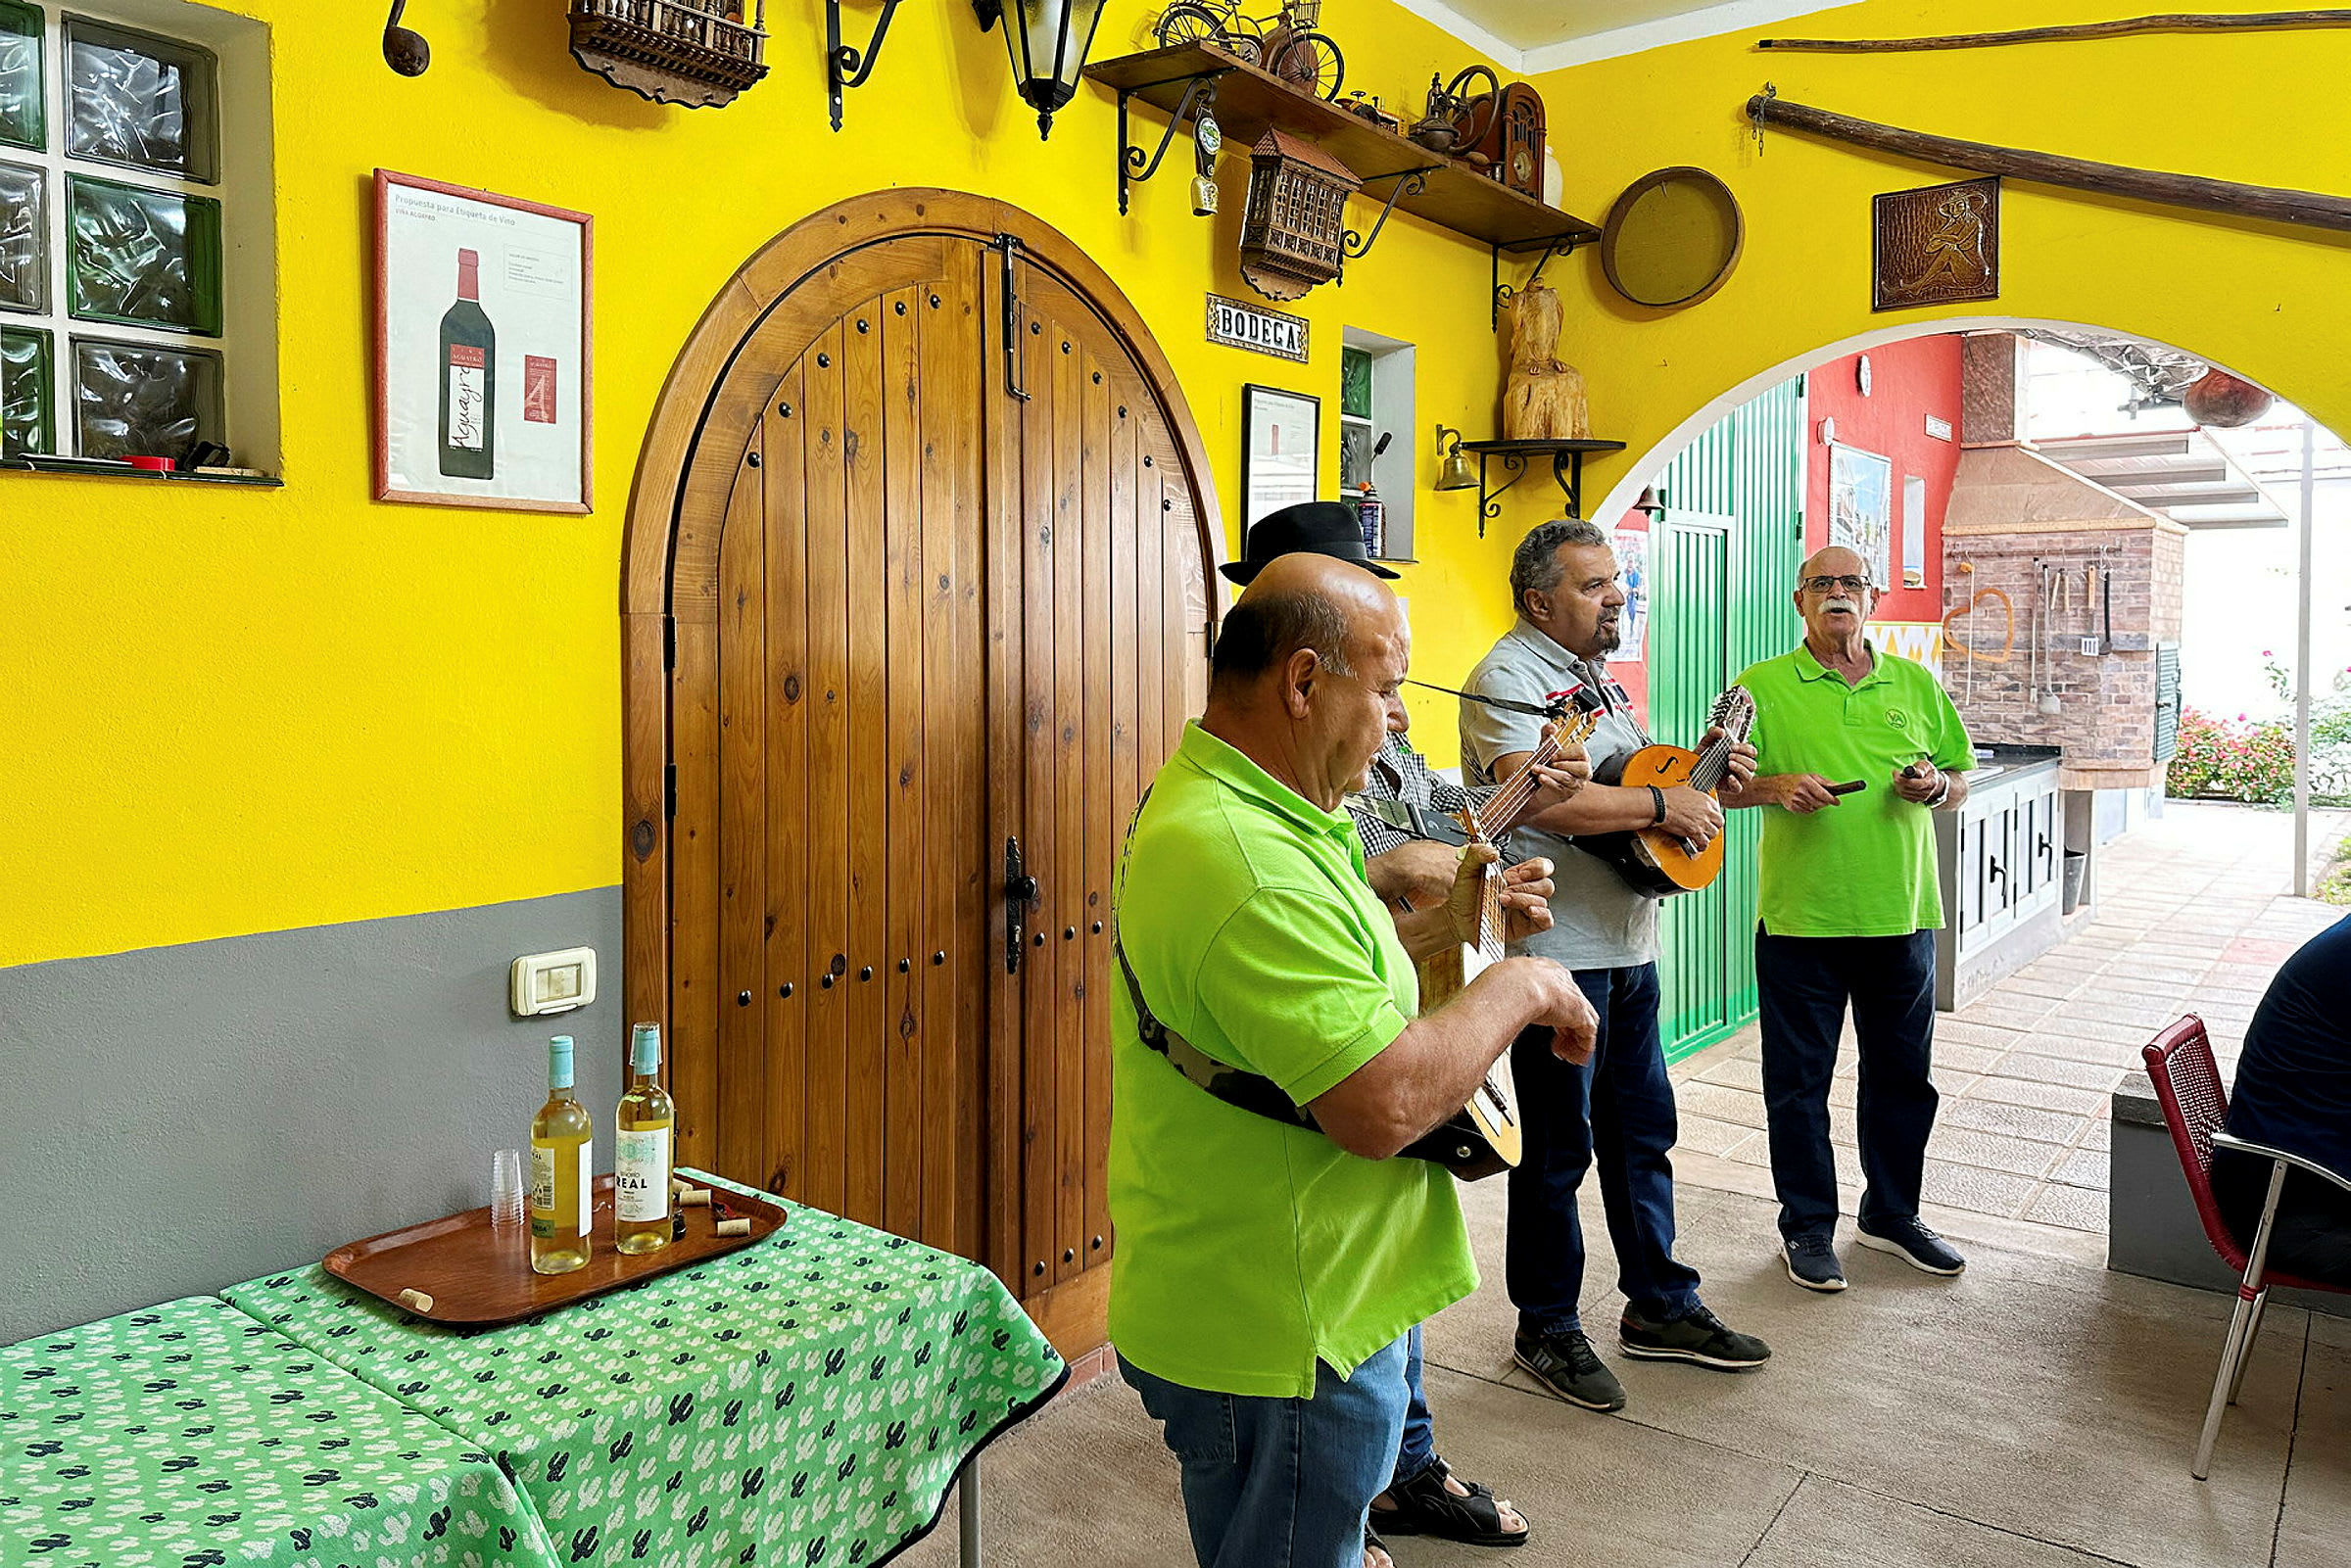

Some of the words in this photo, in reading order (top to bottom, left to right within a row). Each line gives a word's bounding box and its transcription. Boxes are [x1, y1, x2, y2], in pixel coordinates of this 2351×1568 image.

[396, 194, 435, 210] Propuesta
[437, 204, 455, 213] para
[456, 206, 487, 220] Etiqueta
[489, 213, 498, 222] de
[500, 214, 515, 226] Vino
[1222, 308, 1297, 351] BODEGA
